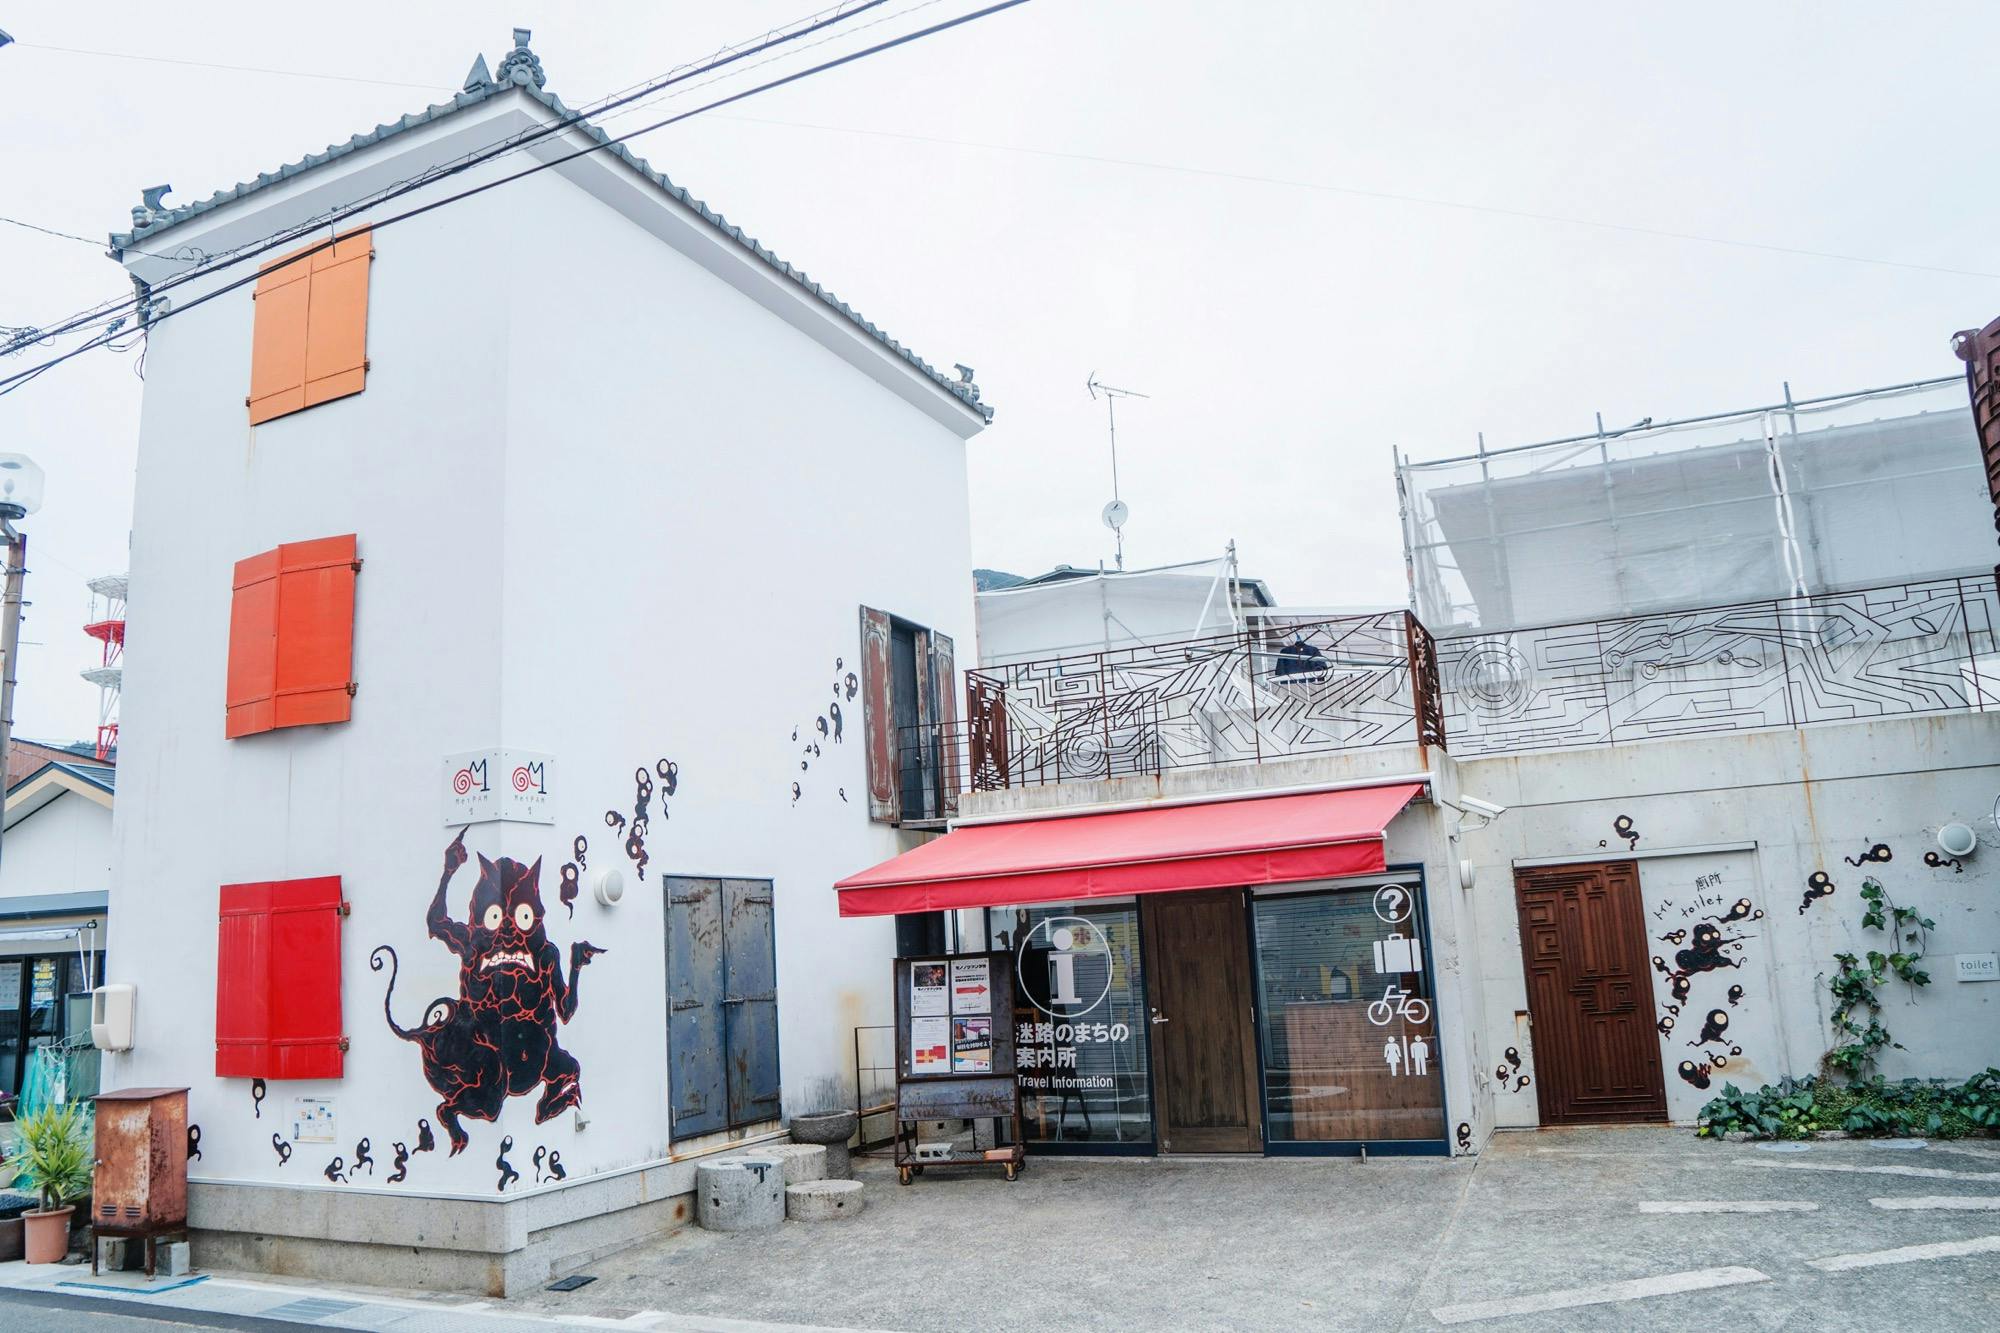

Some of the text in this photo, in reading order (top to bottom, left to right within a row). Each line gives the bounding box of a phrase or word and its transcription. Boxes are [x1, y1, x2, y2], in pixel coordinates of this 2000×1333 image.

[1653, 899, 1673, 920] トイレ
[1680, 894, 1723, 918] toilet
[1960, 960, 1993, 970] toilet
[1016, 1022, 1130, 1044] 迷路のまちの
[1017, 1047, 1077, 1069] 案内所
[1017, 1074, 1114, 1089] Travel Information
